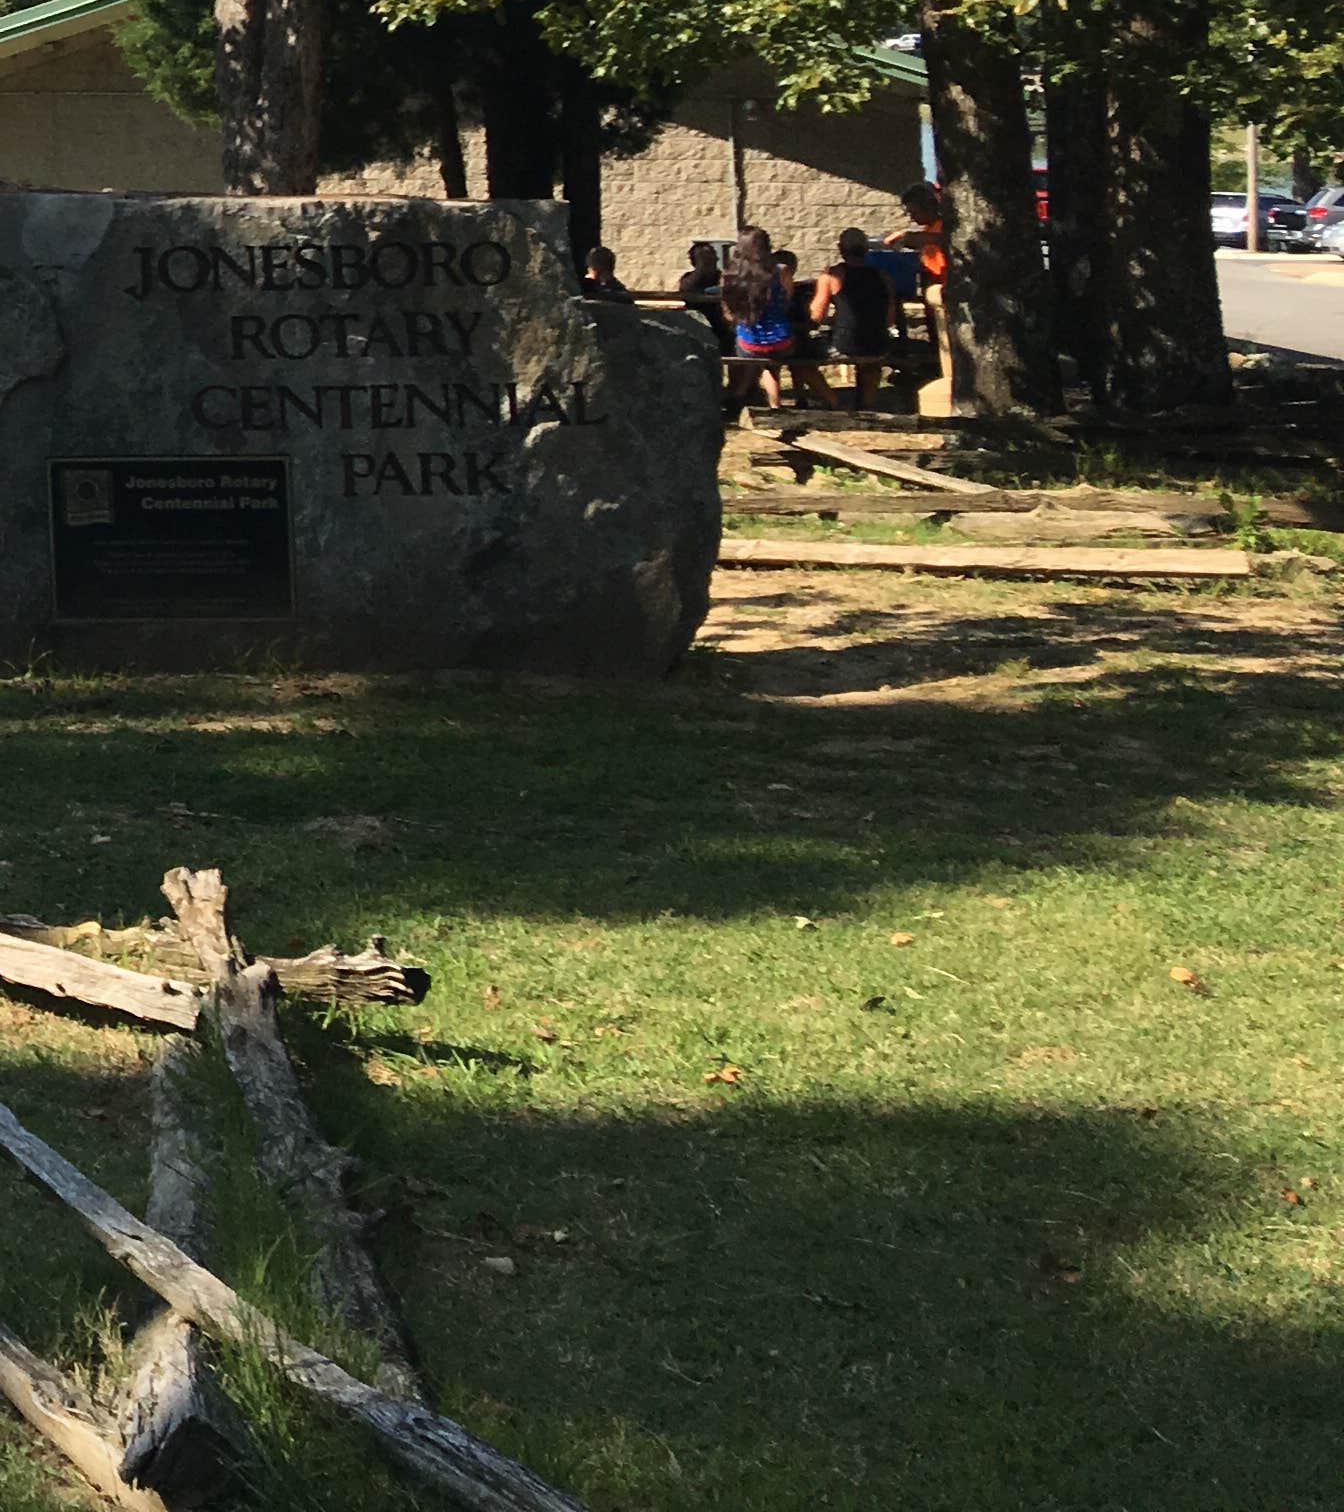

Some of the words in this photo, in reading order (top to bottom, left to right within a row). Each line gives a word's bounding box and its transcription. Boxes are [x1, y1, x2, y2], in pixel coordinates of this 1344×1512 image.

[125, 242, 512, 300] JONESBORO
[228, 310, 481, 362] ROTARY
[191, 382, 609, 430] CENTENNIAL
[124, 474, 216, 489] Jonesboro
[219, 474, 279, 491] Rotary
[341, 451, 513, 498] PARK
[140, 496, 235, 510] Centennial
[239, 496, 280, 510] Park
